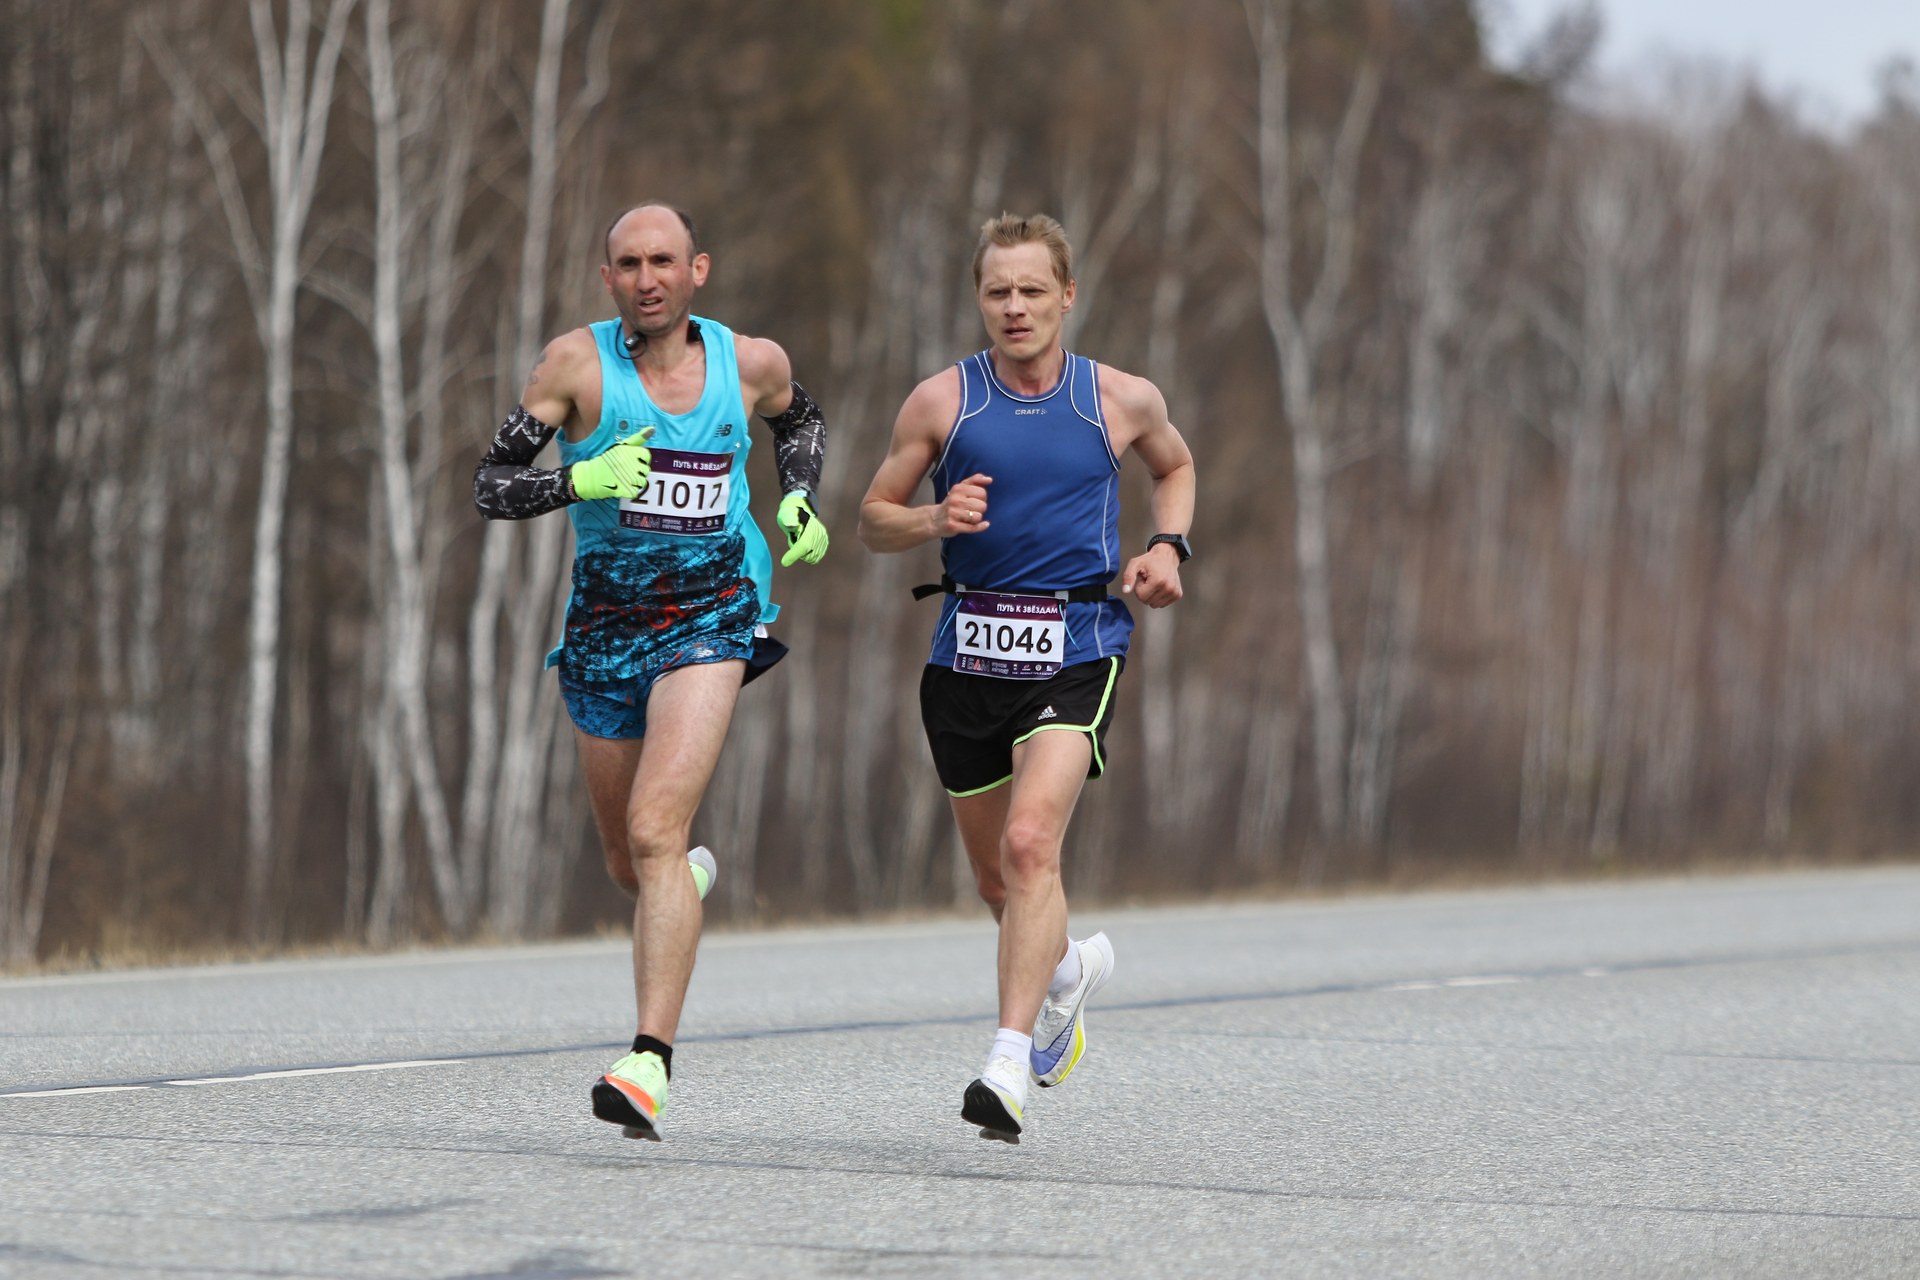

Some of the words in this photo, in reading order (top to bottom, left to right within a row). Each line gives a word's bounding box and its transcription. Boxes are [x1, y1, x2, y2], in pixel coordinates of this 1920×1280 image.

[672, 460, 692, 470] ПУТЬ
[630, 480, 722, 510] 21017
[996, 604, 1014, 612] ПУТЬ
[1022, 604, 1058, 614] ЗВЁЗДАМ
[964, 620, 1052, 654] 21046
